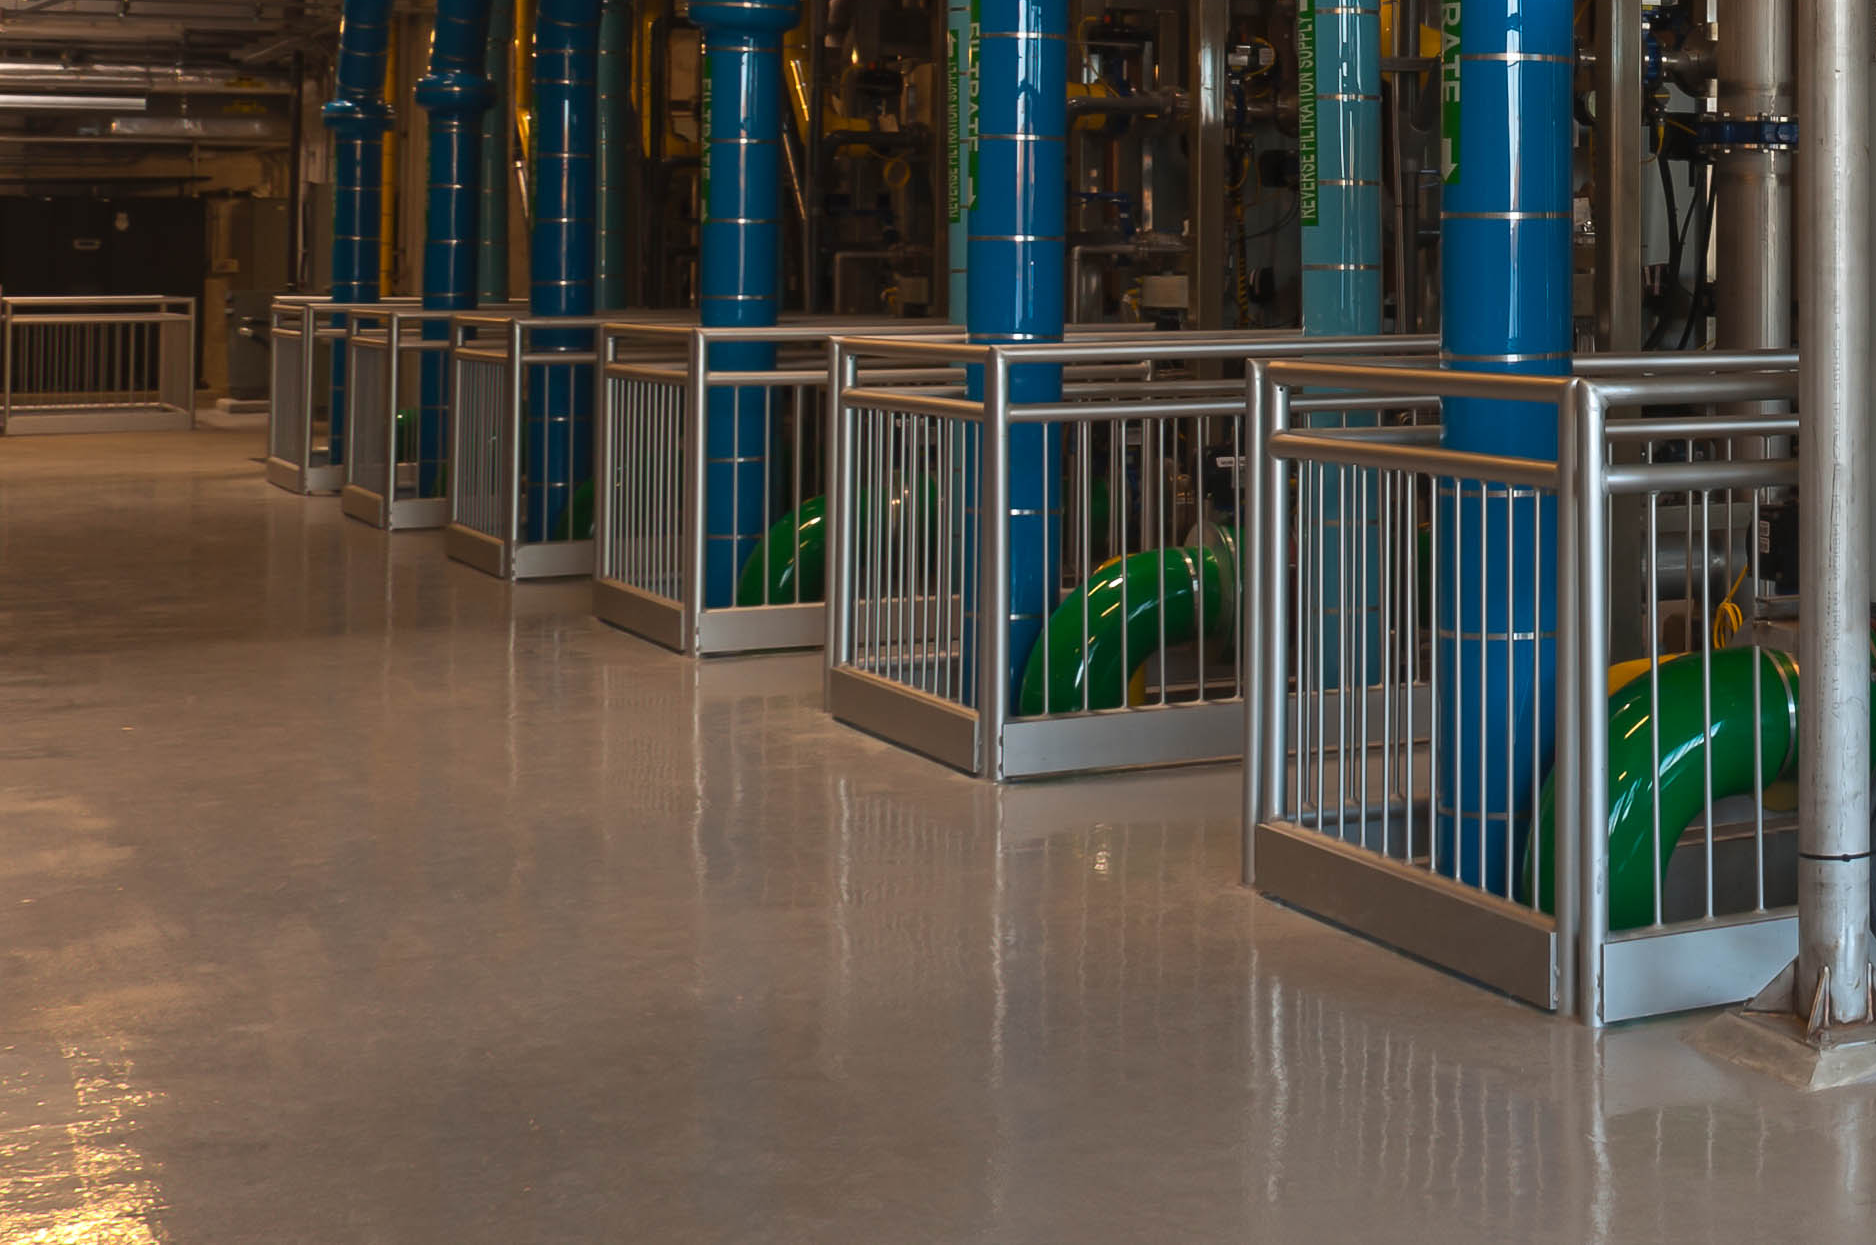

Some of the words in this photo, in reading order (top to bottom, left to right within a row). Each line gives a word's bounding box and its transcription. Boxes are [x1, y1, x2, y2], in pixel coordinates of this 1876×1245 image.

[1299, 16, 1313, 68] SUPPLY
[1300, 72, 1315, 151] FILTRATION
[1301, 154, 1316, 219] REVERSE
